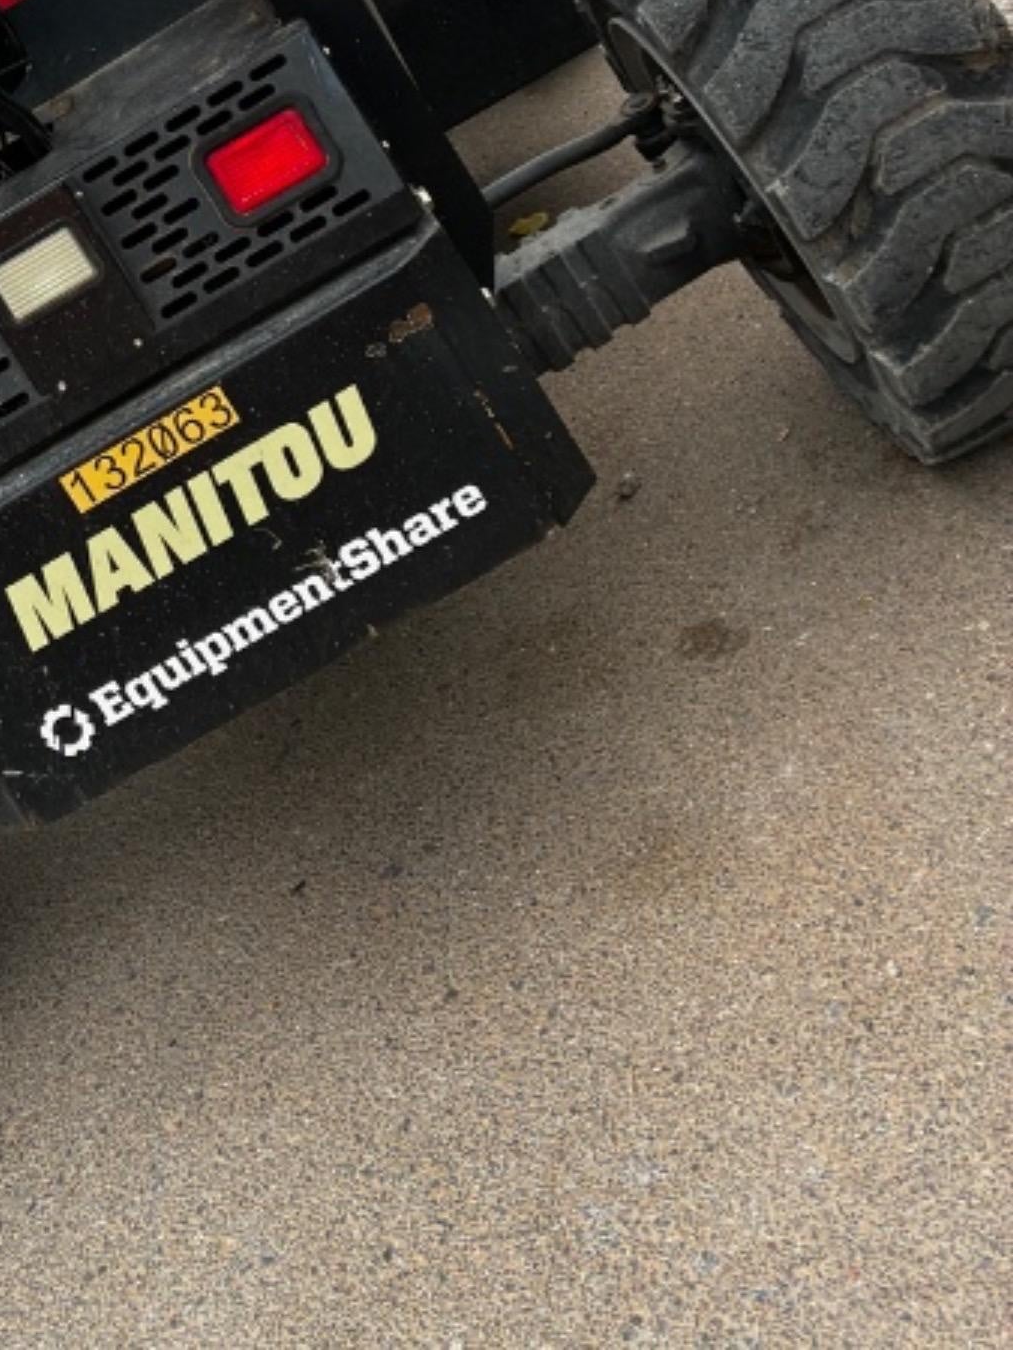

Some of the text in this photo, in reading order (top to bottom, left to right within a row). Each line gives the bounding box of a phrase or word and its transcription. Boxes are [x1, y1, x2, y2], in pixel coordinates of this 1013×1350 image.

[4, 383, 378, 652] MANITOU
[70, 393, 233, 503] 132063
[88, 482, 488, 727] EquipmentShare
